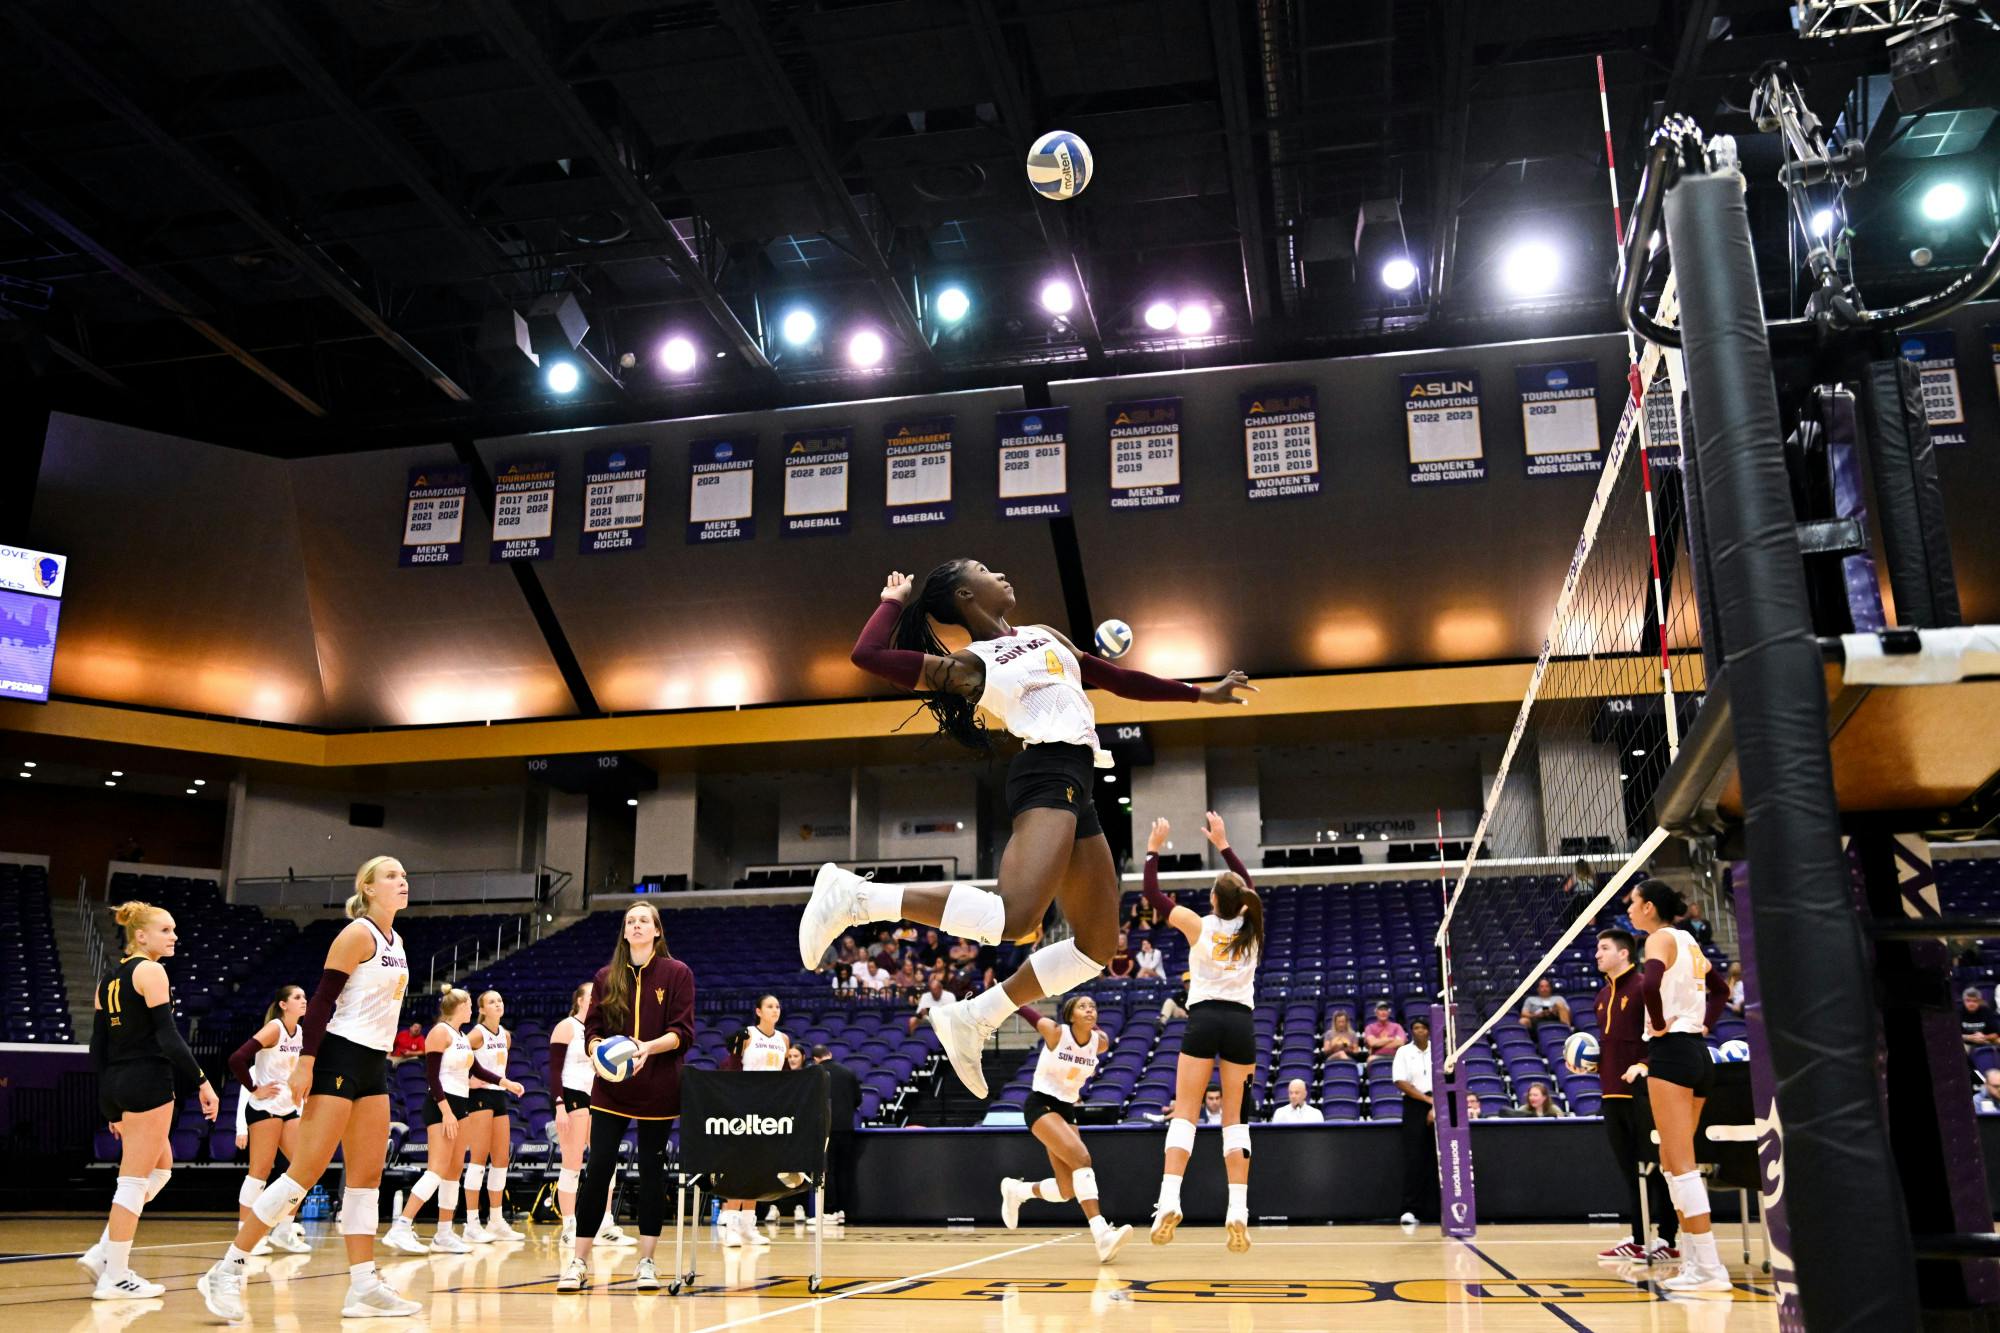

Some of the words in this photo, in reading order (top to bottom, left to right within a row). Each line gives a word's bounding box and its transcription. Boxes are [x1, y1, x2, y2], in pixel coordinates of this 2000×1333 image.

[1061, 153, 1072, 190] molten
[1410, 380, 1473, 396] ASUN
[1923, 386, 1952, 396] 2011
[1522, 388, 1595, 401] TOURNAMENT
[1406, 397, 1478, 410] CHAMPIONS
[1925, 398, 1954, 408] 2015
[1529, 405, 1556, 416] 2023
[1245, 412, 1316, 426] CHAMPIONS
[1413, 413, 1440, 423] 2022
[1446, 411, 1473, 422] 2023
[1110, 424, 1178, 437] CHAMPIONS
[1252, 429, 1277, 440] 2011
[1284, 426, 1310, 436] 2012
[888, 432, 951, 446] TOURNAMENT
[1002, 434, 1064, 446] REGIONALS
[1116, 440, 1142, 450] 2013
[1148, 438, 1173, 448] 2014
[1253, 440, 1278, 450] 2013
[1284, 438, 1310, 448] 2014
[886, 442, 952, 456] CHAMPIONS
[1005, 450, 1030, 459] 2008
[1035, 448, 1060, 458] 2015
[786, 452, 848, 466] CHAMPIONS
[1117, 452, 1142, 462] 2015
[1148, 450, 1174, 459] 2017
[1253, 452, 1278, 462] 2015
[1286, 449, 1312, 459] 2016
[1534, 452, 1592, 464] WOMEN'S
[692, 460, 754, 473] TOURNAMENT
[892, 459, 916, 468] 2008
[922, 456, 946, 466] 2015
[1004, 461, 1030, 471] 2023
[1254, 463, 1280, 474] 2018
[1286, 460, 1312, 470] 2019
[1418, 460, 1475, 472] WOMEN'S
[1528, 464, 1558, 475] CROSS
[1560, 460, 1602, 474] COUNTRY
[497, 471, 555, 483] TOURNAMENT
[587, 470, 646, 482] TOURNAMENT
[790, 468, 814, 478] 2022
[820, 466, 844, 476] 2023
[892, 470, 916, 480] 2023
[1411, 471, 1441, 483] CROSS
[1442, 468, 1484, 480] COUNTRY
[496, 480, 556, 492] CHAMPIONS
[697, 476, 720, 486] 2023
[1256, 475, 1310, 488] WOMEN'S
[409, 486, 466, 498] CHAMPIONS
[590, 486, 613, 496] 2017
[1128, 487, 1164, 497] MEN'S
[1249, 488, 1278, 498] CROSS
[1280, 484, 1320, 496] COUNTRY
[500, 496, 522, 505] 2017
[590, 496, 612, 506] 2018
[615, 494, 634, 504] SWEET
[1112, 497, 1140, 507] CROSS
[1142, 494, 1180, 506] COUNTRY
[413, 502, 434, 511] 2014
[499, 507, 521, 516] 2021
[526, 504, 548, 514] 2022
[590, 507, 612, 516] 2021
[1006, 504, 1060, 516] BASEBALL
[412, 512, 432, 522] 2021
[438, 510, 458, 520] 2022
[498, 517, 520, 526] 2023
[590, 518, 612, 528] 2022
[624, 515, 642, 524] ROUND
[892, 512, 946, 524] BASEBALL
[410, 522, 432, 532] 2023
[704, 520, 736, 530] MEN'S
[790, 517, 841, 529] BASEBALL
[598, 530, 628, 540] MEN'S
[700, 528, 740, 540] SOCCER
[416, 545, 446, 554] MEN'S
[506, 540, 536, 550] MEN'S
[594, 538, 632, 550] SOCCER
[412, 553, 449, 562] SOCCER
[502, 548, 540, 558] SOCCER
[1045, 649, 1065, 676] 4
[1607, 700, 1633, 712] 104
[1118, 726, 1142, 739] 104
[528, 760, 548, 770] 106
[597, 756, 618, 768] 105
[382, 956, 399, 967] SUN
[108, 978, 121, 1014] 11
[1058, 1052, 1074, 1062] SUN
[706, 1114, 793, 1135] molten
[433, 1273, 1776, 1304] LIPSC
